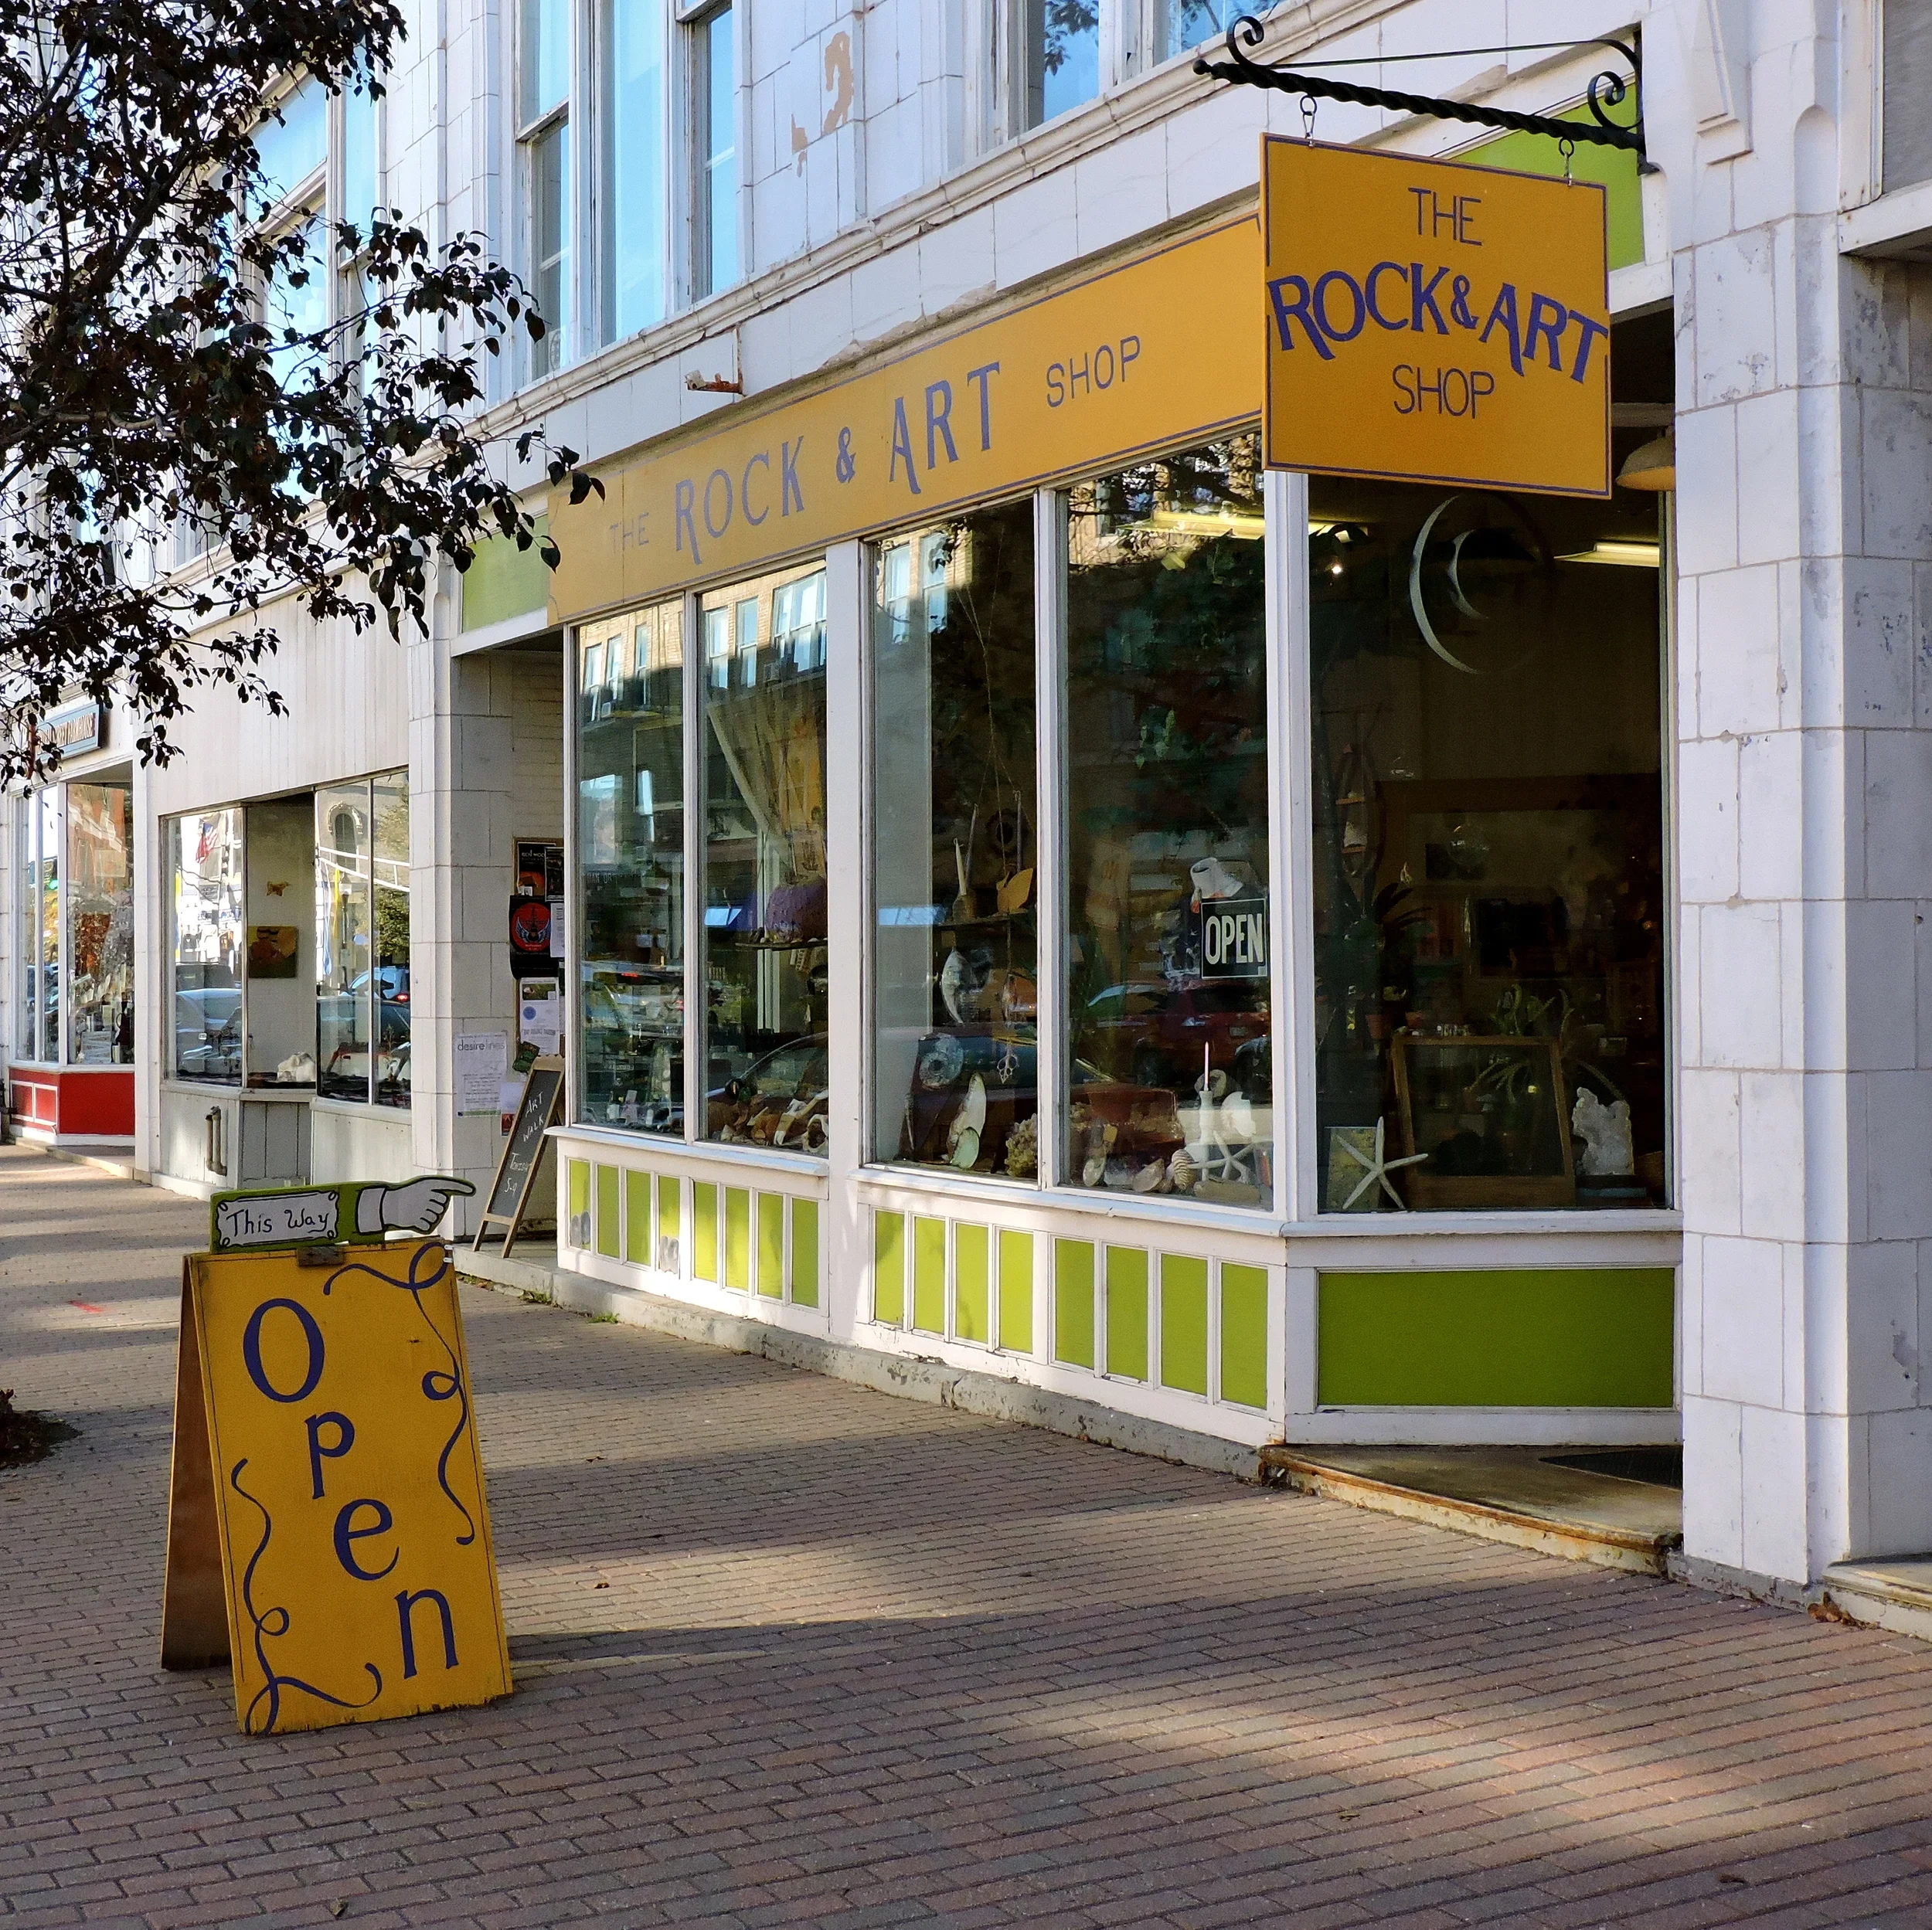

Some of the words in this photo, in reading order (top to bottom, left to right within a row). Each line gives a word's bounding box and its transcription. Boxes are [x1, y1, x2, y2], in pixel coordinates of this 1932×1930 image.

[1408, 187, 1483, 246] THE
[1392, 364, 1495, 420] SHOP
[609, 511, 650, 554] THE
[675, 435, 804, 566] ROCK
[835, 426, 856, 484] &
[889, 360, 1000, 495] ART
[1046, 335, 1141, 408] SHOP
[1205, 913, 1264, 965] OPEN
[522, 1113, 545, 1142] WALK
[525, 1091, 543, 1118] ART
[226, 1208, 273, 1237] This
[284, 1208, 330, 1234] Way
